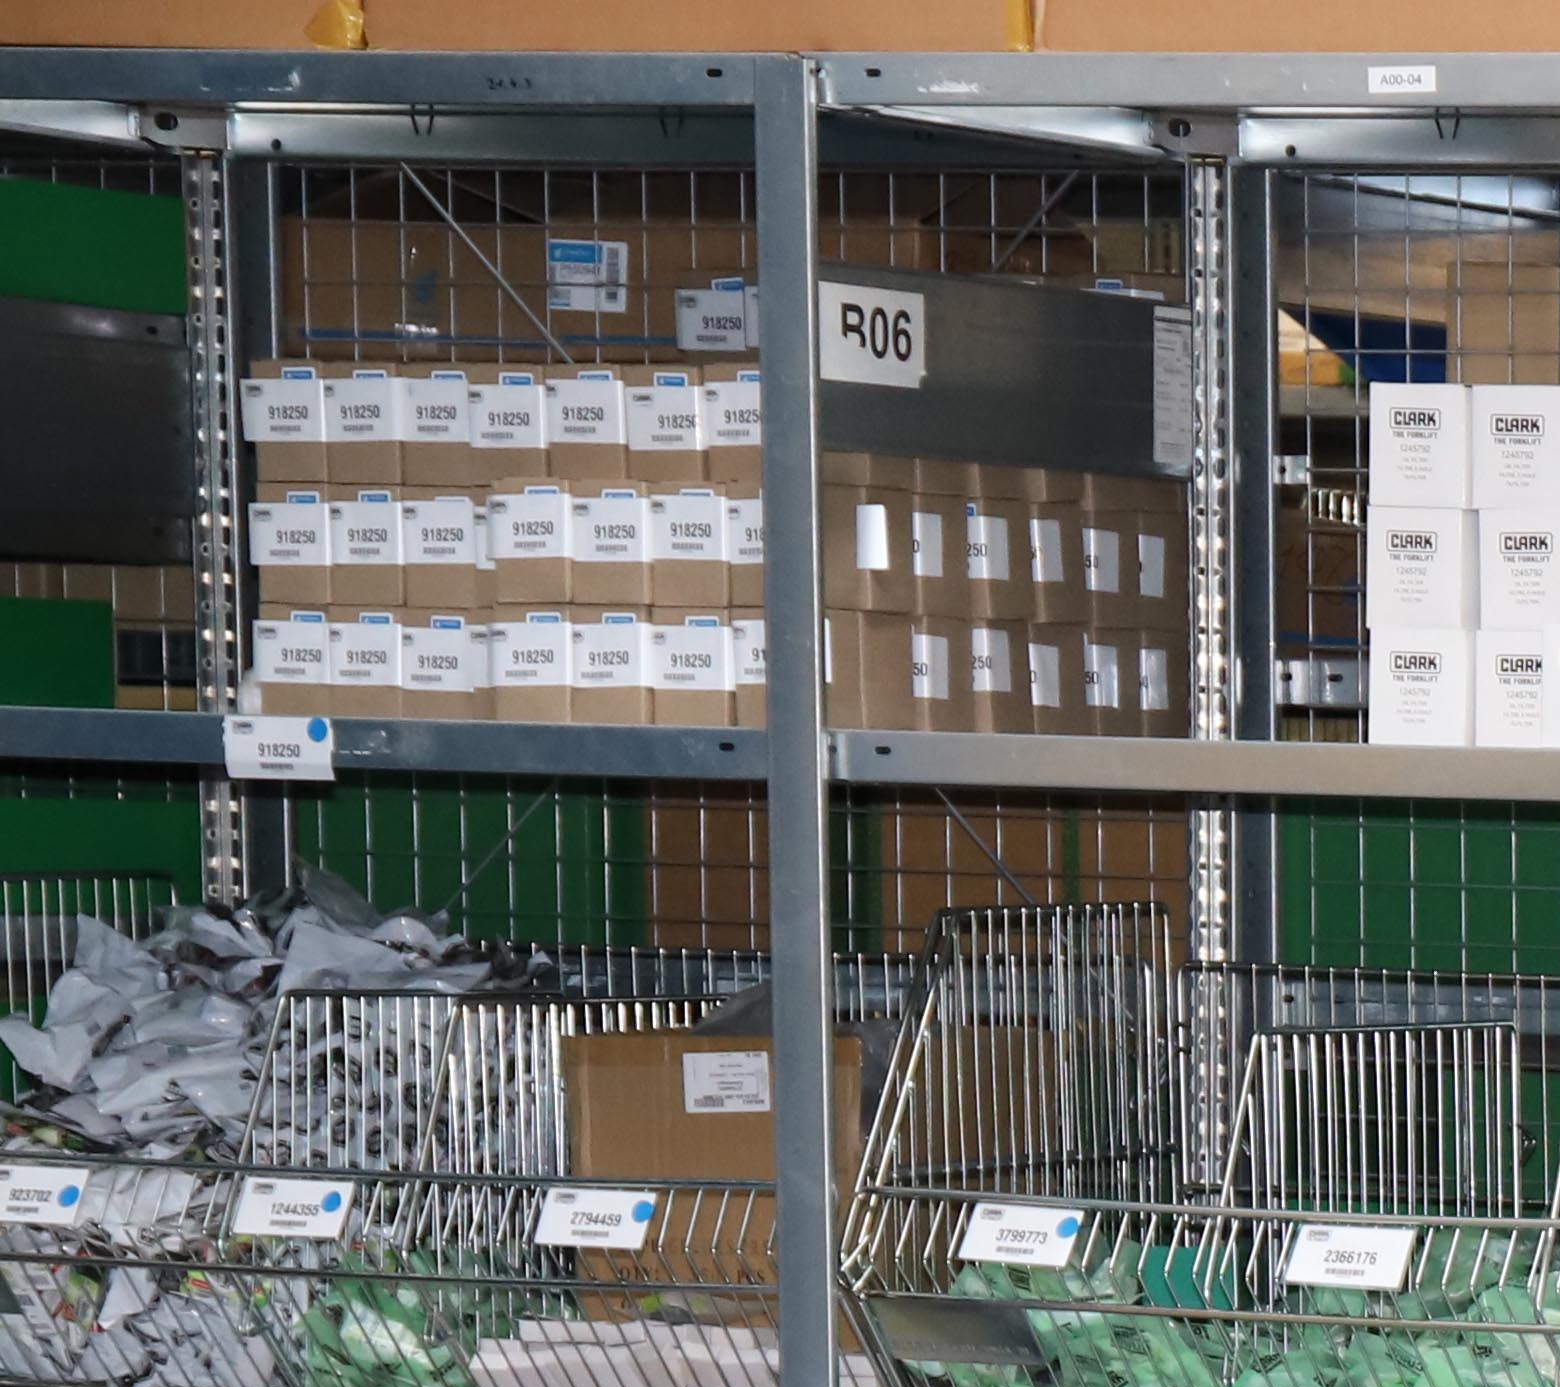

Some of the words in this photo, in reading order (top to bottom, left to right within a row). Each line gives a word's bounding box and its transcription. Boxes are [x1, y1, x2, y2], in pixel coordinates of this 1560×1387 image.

[703, 316, 742, 331] 918250
[268, 405, 308, 420] 918250
[341, 404, 380, 420] 918250
[416, 405, 456, 420] 918250
[488, 411, 529, 426] 918250
[562, 406, 603, 421] 918250
[1394, 411, 1437, 426] CLARK
[1495, 417, 1540, 433] CLARK
[348, 528, 387, 542] 918250
[422, 528, 463, 542] 918250
[512, 521, 554, 536] 918250
[593, 524, 635, 540] 918250
[670, 522, 712, 538] 918250
[276, 530, 315, 544] 918250
[1391, 534, 1433, 549] CLARK
[1504, 536, 1548, 551] CLARK
[281, 648, 321, 663] 918250
[418, 655, 458, 669] 918250
[512, 650, 554, 664] 918250
[670, 653, 711, 668] 918250
[1394, 655, 1437, 670] CLARK
[258, 743, 300, 757] 918250
[271, 1202, 319, 1216] 1244355
[570, 1211, 621, 1227] 2794459
[995, 1227, 1047, 1245] 3799773
[1323, 1248, 1377, 1266] 2366176
